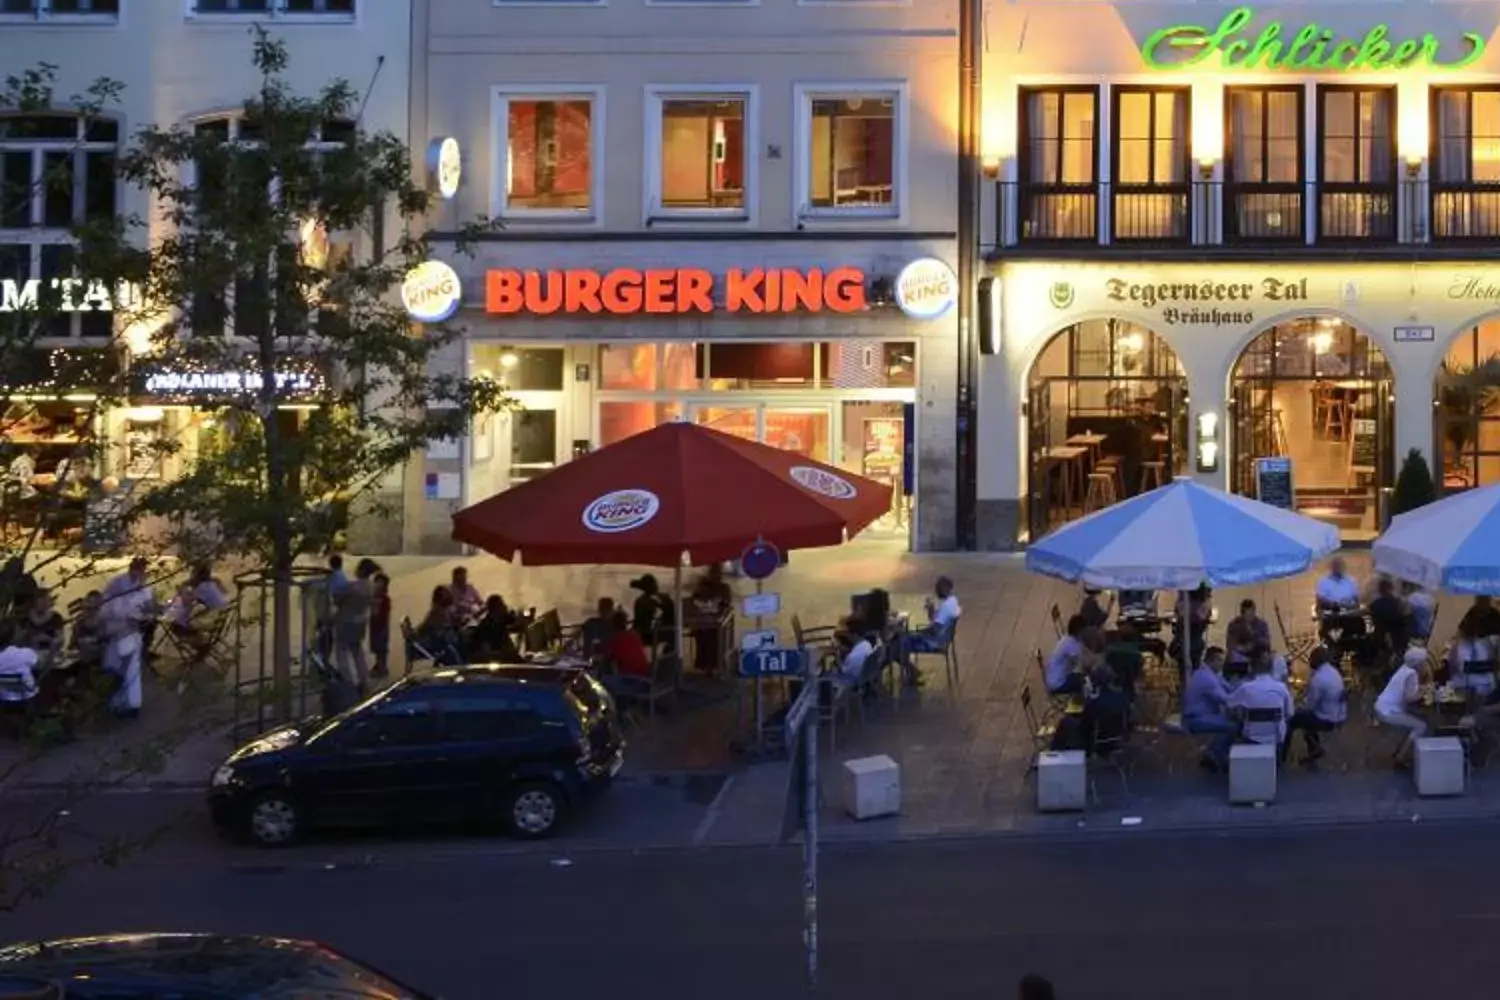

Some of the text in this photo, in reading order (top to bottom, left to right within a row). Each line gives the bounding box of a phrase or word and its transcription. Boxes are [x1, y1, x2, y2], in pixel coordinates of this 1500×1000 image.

[1141, 6, 1486, 71] Schlicker
[407, 278, 455, 311] KING
[484, 268, 716, 314] BURGER
[726, 266, 866, 314] KING
[904, 280, 950, 306] KING
[1106, 277, 1309, 308] Tegernseer Tal
[1161, 306, 1254, 328] Bräuhaus
[757, 652, 787, 671] Tal
